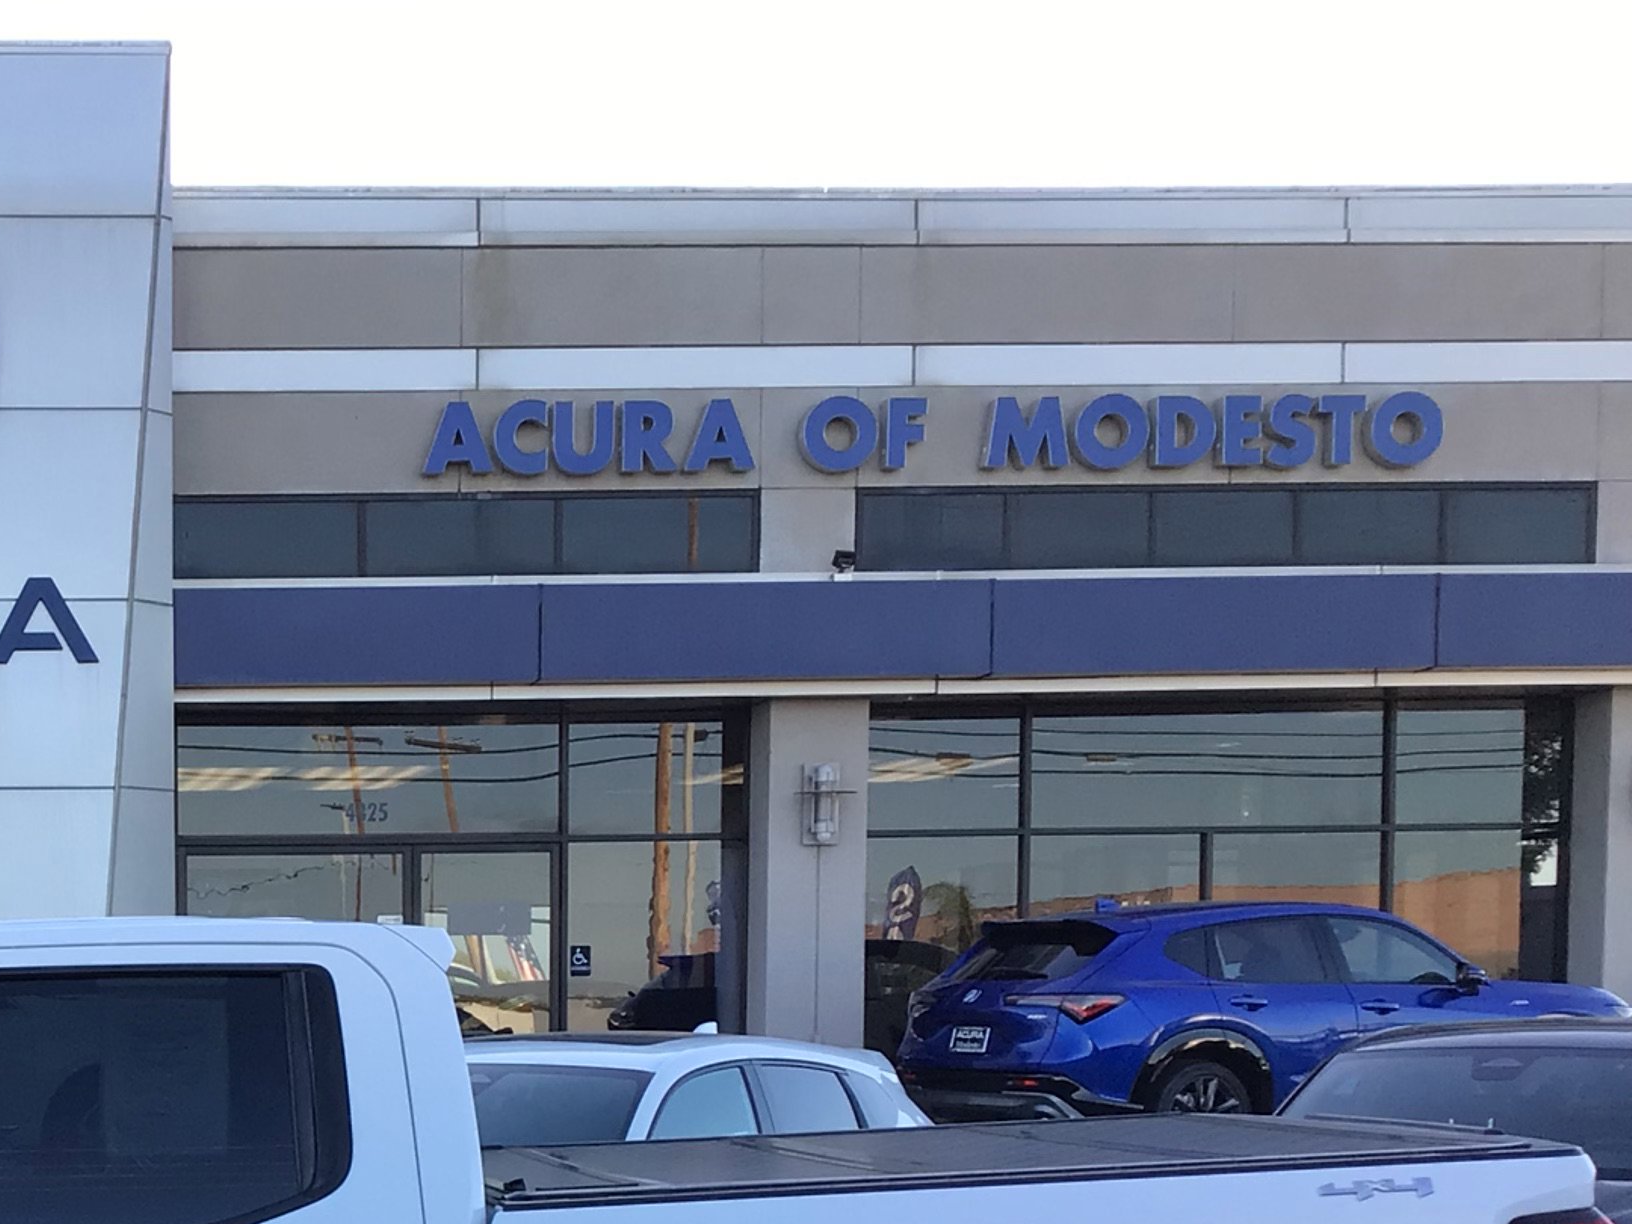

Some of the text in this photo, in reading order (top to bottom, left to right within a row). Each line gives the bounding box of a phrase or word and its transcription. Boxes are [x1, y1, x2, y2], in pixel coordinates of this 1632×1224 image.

[422, 390, 1444, 476] ACURA OF MODESTO
